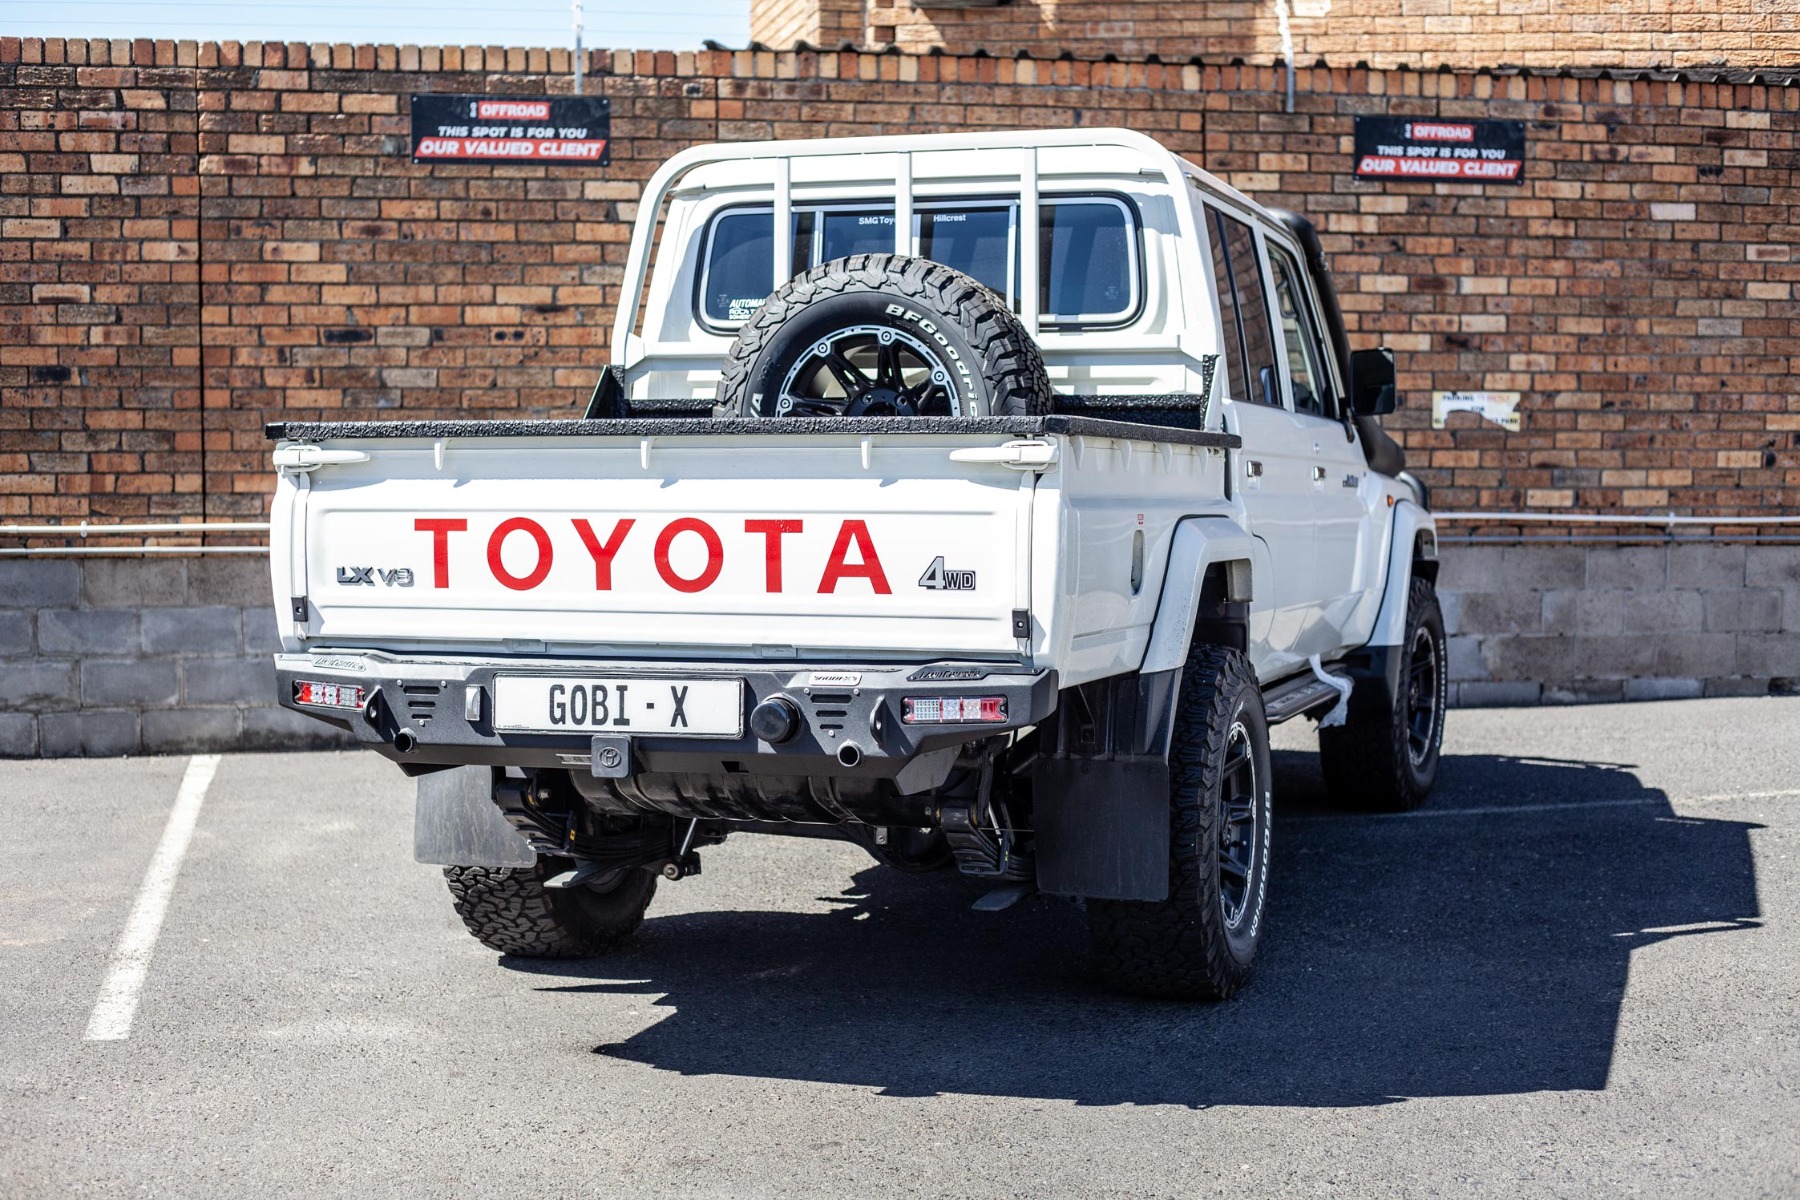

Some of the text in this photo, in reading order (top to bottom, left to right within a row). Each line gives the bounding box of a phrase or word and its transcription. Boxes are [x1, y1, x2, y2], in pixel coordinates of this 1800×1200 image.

[481, 104, 546, 117] OFFROAD
[438, 126, 587, 139] THIS SPOT IS FOR YOU
[1413, 125, 1472, 139] OFFROAD
[420, 140, 601, 156] OUR VALUED CLIENT
[1377, 145, 1506, 159] THIS SPOT IS FOR YOU
[1360, 158, 1517, 176] OUR VALUED CLIENT
[859, 214, 966, 225] SMG Toy Hillcrest
[885, 303, 978, 417] BFGoodric
[414, 517, 893, 594] TOYOTA
[336, 566, 415, 587] LX V8
[918, 555, 976, 590] 4WD
[550, 684, 630, 726] GOBI
[670, 685, 688, 727] X
